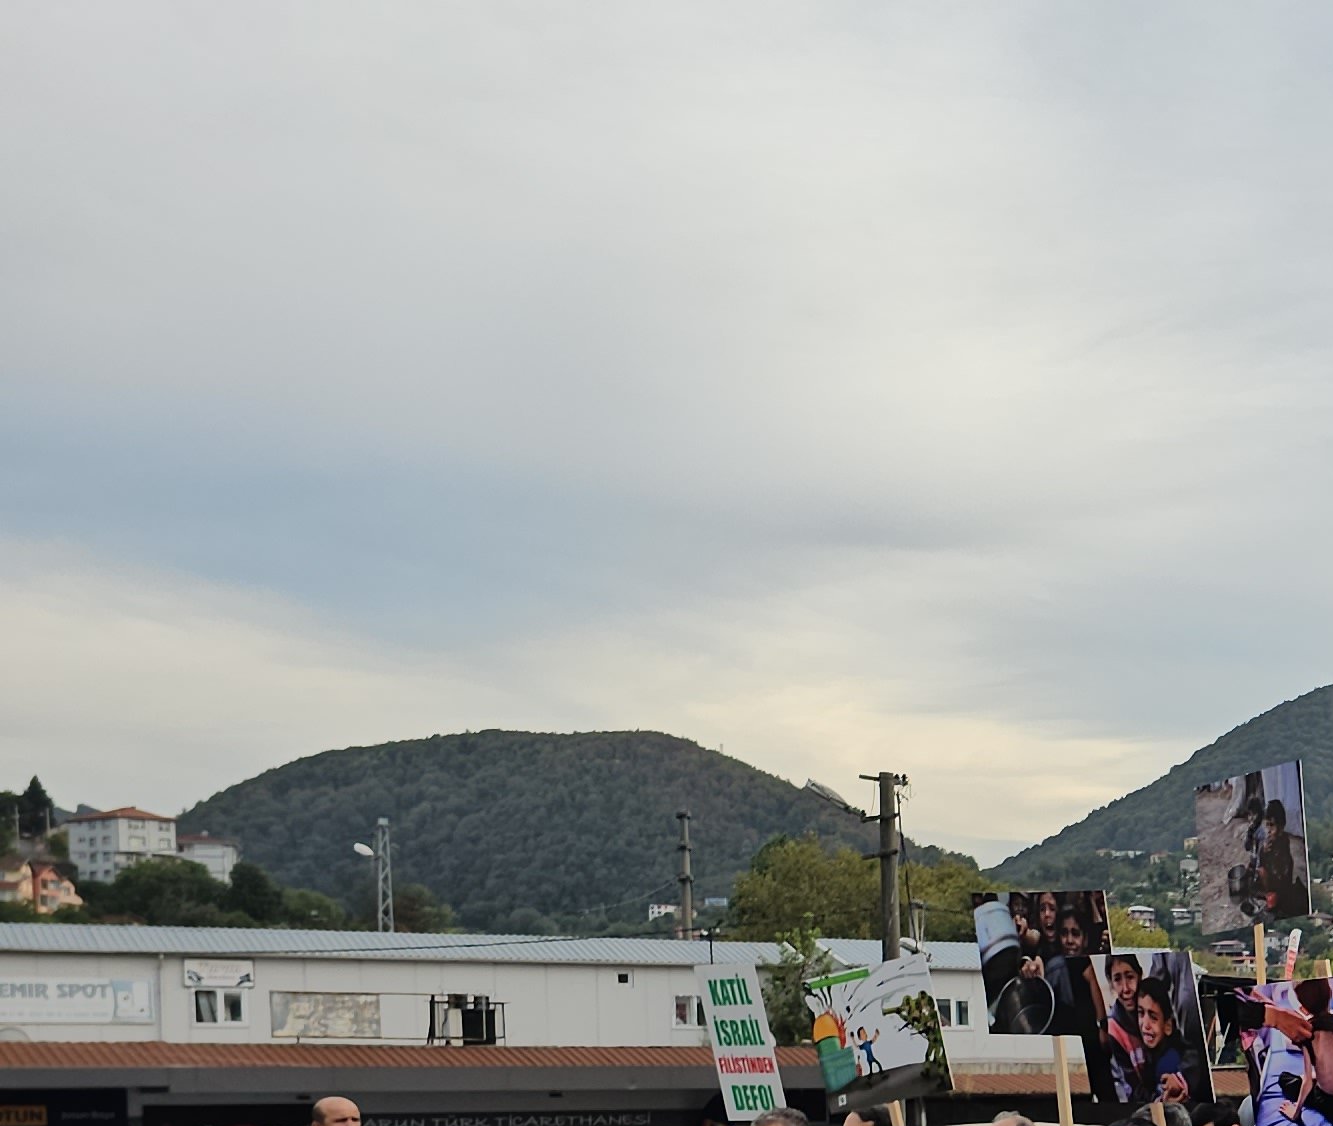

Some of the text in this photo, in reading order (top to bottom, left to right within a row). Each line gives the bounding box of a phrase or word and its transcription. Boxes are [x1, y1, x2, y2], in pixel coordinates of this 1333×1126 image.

[56, 983, 109, 999] SPOT
[708, 973, 753, 1006] KATİL
[713, 1014, 765, 1047] İSRAİL
[718, 1053, 775, 1075] FİLİSTİNDEN
